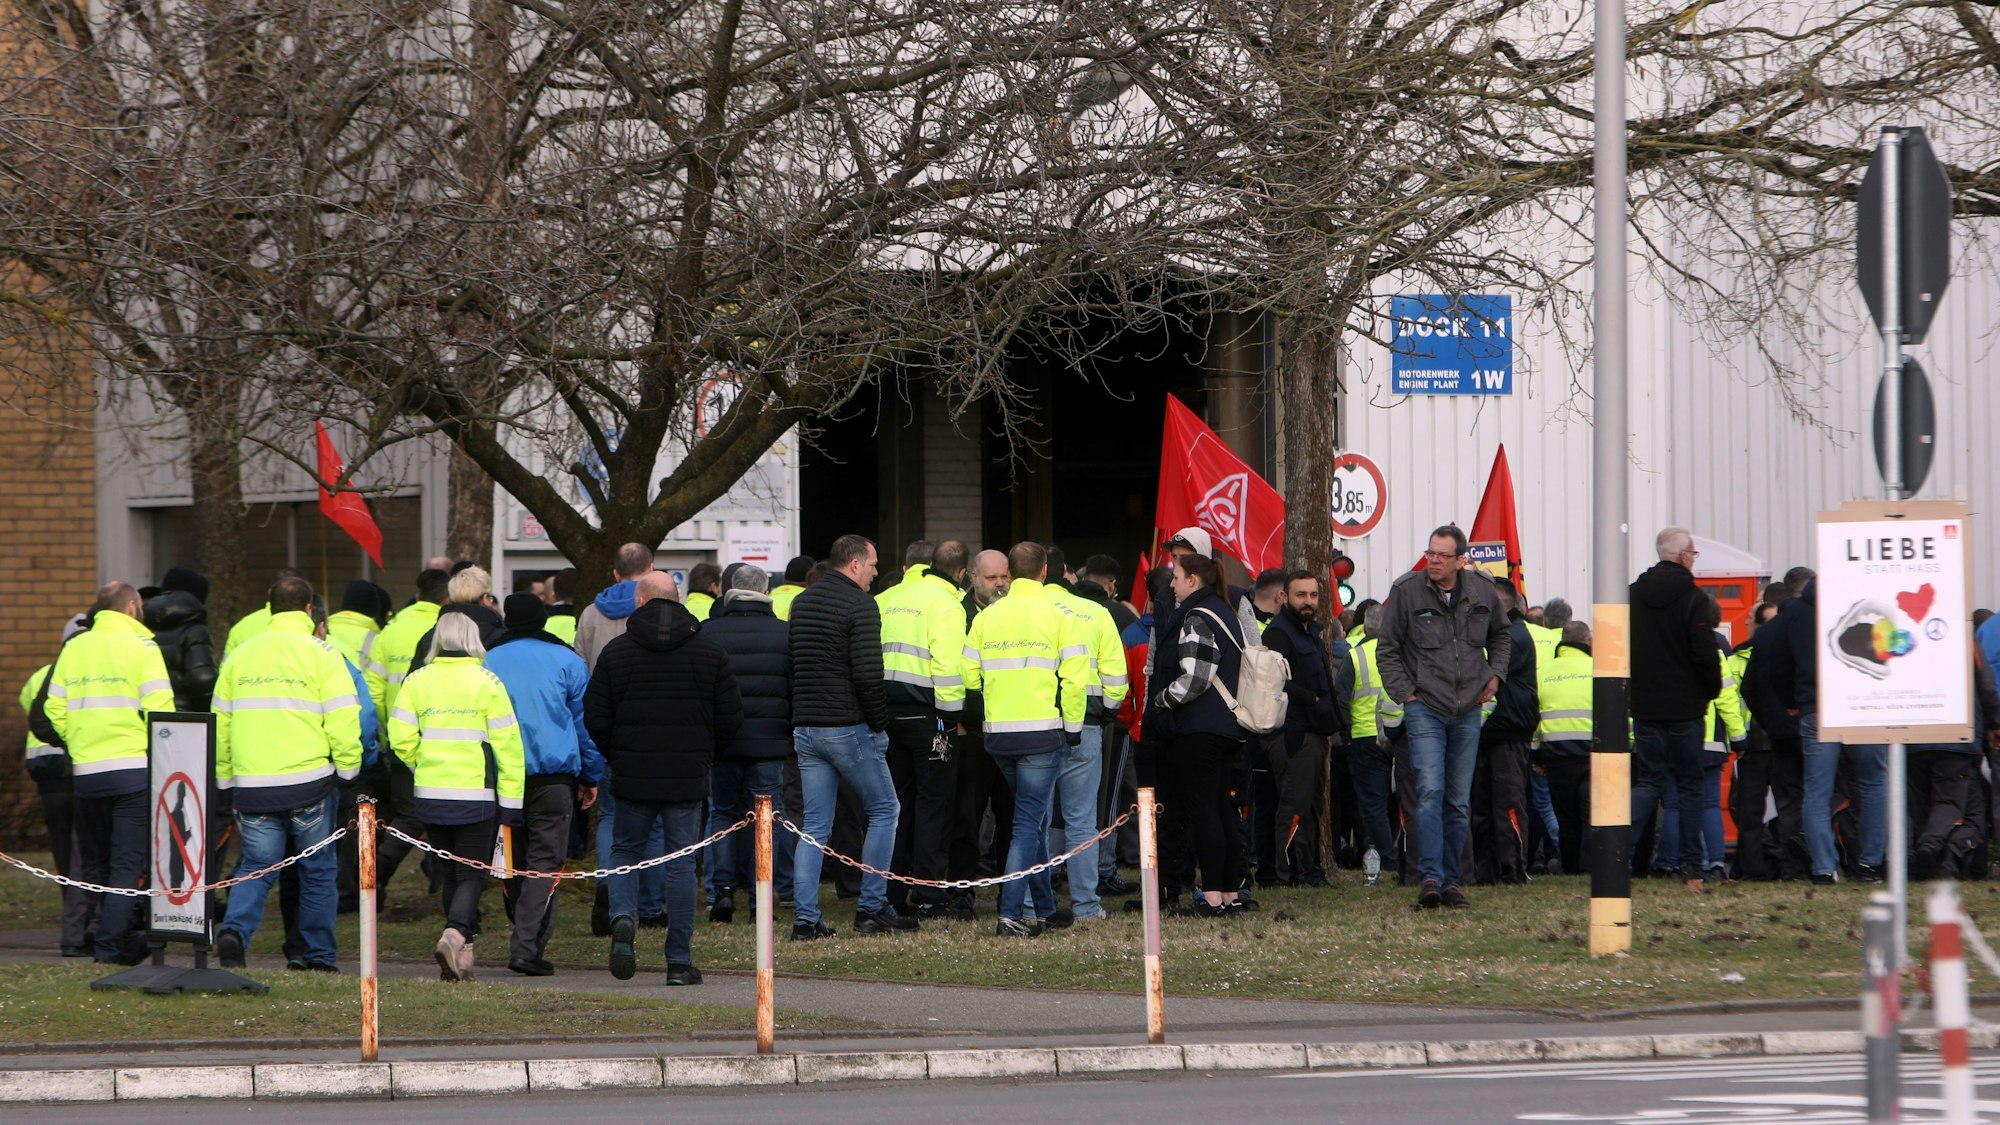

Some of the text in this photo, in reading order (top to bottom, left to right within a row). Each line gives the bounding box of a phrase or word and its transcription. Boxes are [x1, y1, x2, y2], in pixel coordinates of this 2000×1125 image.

[1399, 316, 1506, 338] DOCK 11
[1399, 369, 1460, 379] MOTORENWERK
[1471, 369, 1505, 390] 1W
[1399, 380, 1459, 389] ENGINE PLANT
[1470, 547, 1485, 558] Can
[1485, 546, 1497, 557] Do
[1497, 545, 1506, 557] It!
[1846, 537, 1936, 561] LIEBE
[1864, 562, 1942, 575] STATT HASS
